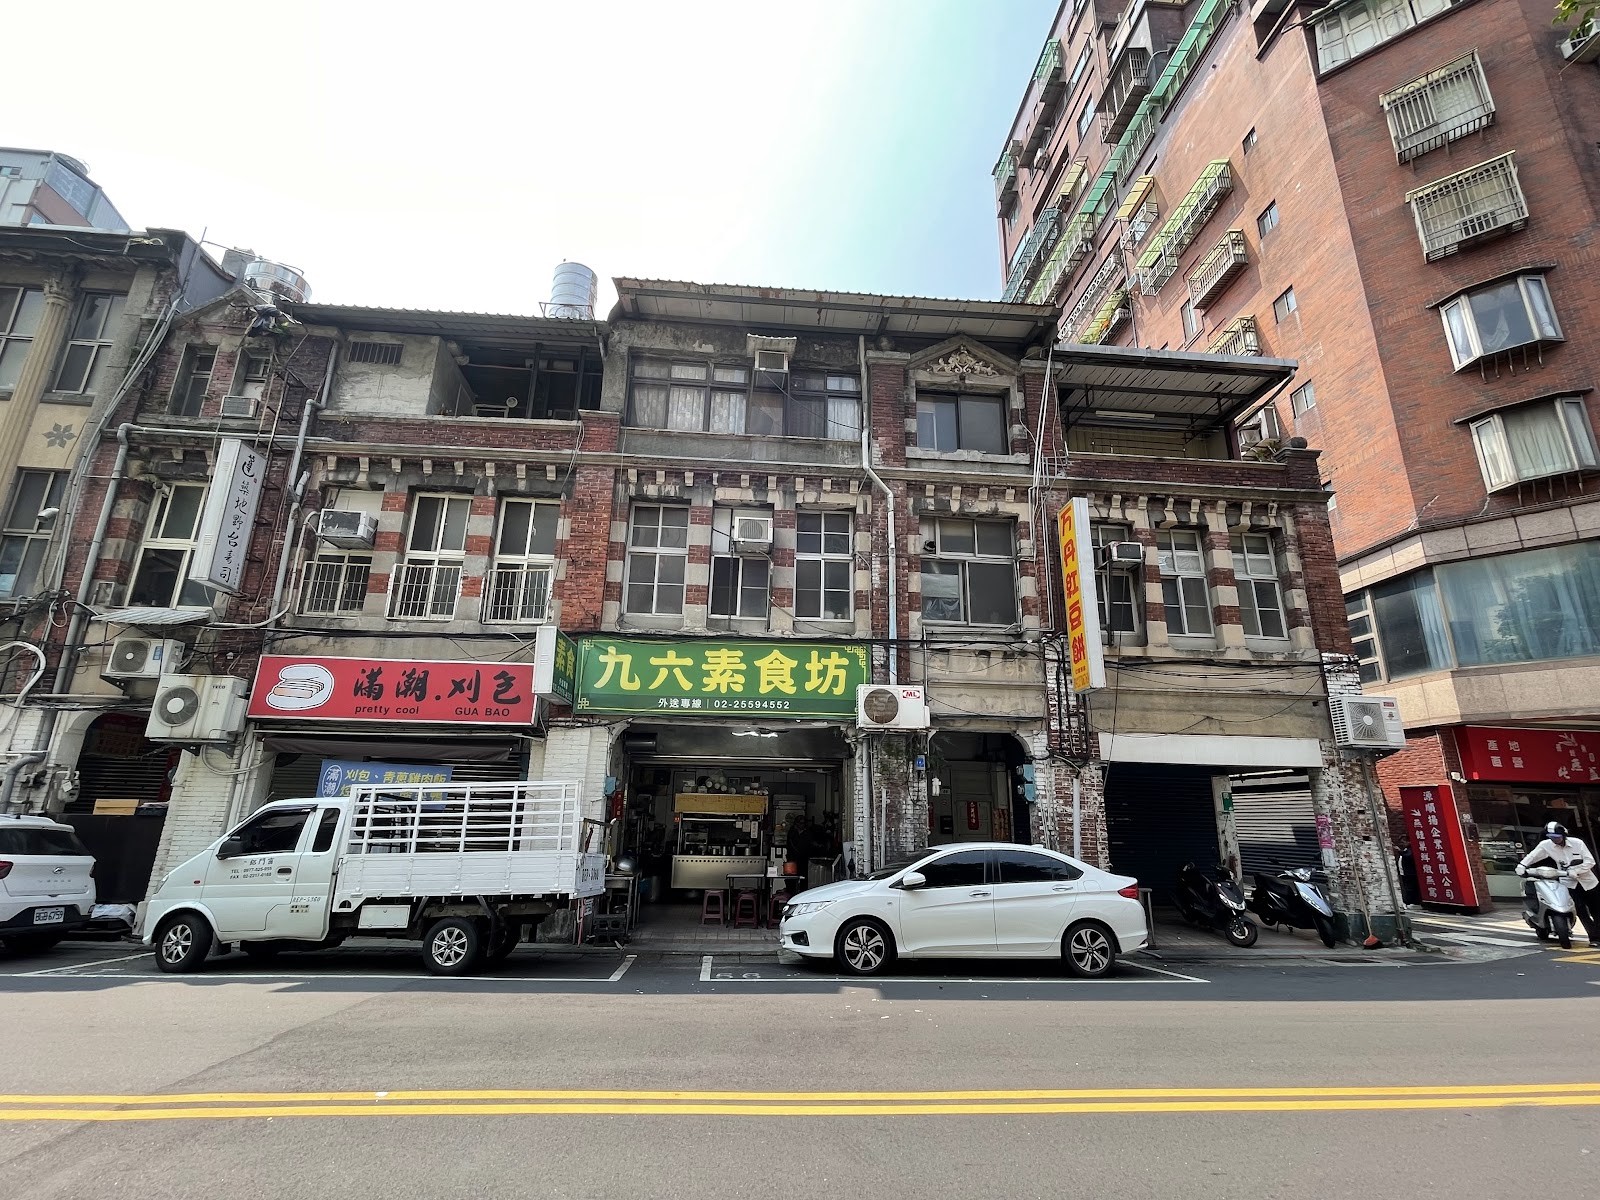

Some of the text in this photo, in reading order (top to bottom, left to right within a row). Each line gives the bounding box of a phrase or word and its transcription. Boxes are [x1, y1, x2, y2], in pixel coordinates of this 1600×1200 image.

[593, 645, 849, 695] 九六素食坊
[658, 698, 790, 709] 外送專線 02-25594552
[354, 705, 419, 715] pretty cool
[455, 707, 510, 717] GUA BAO
